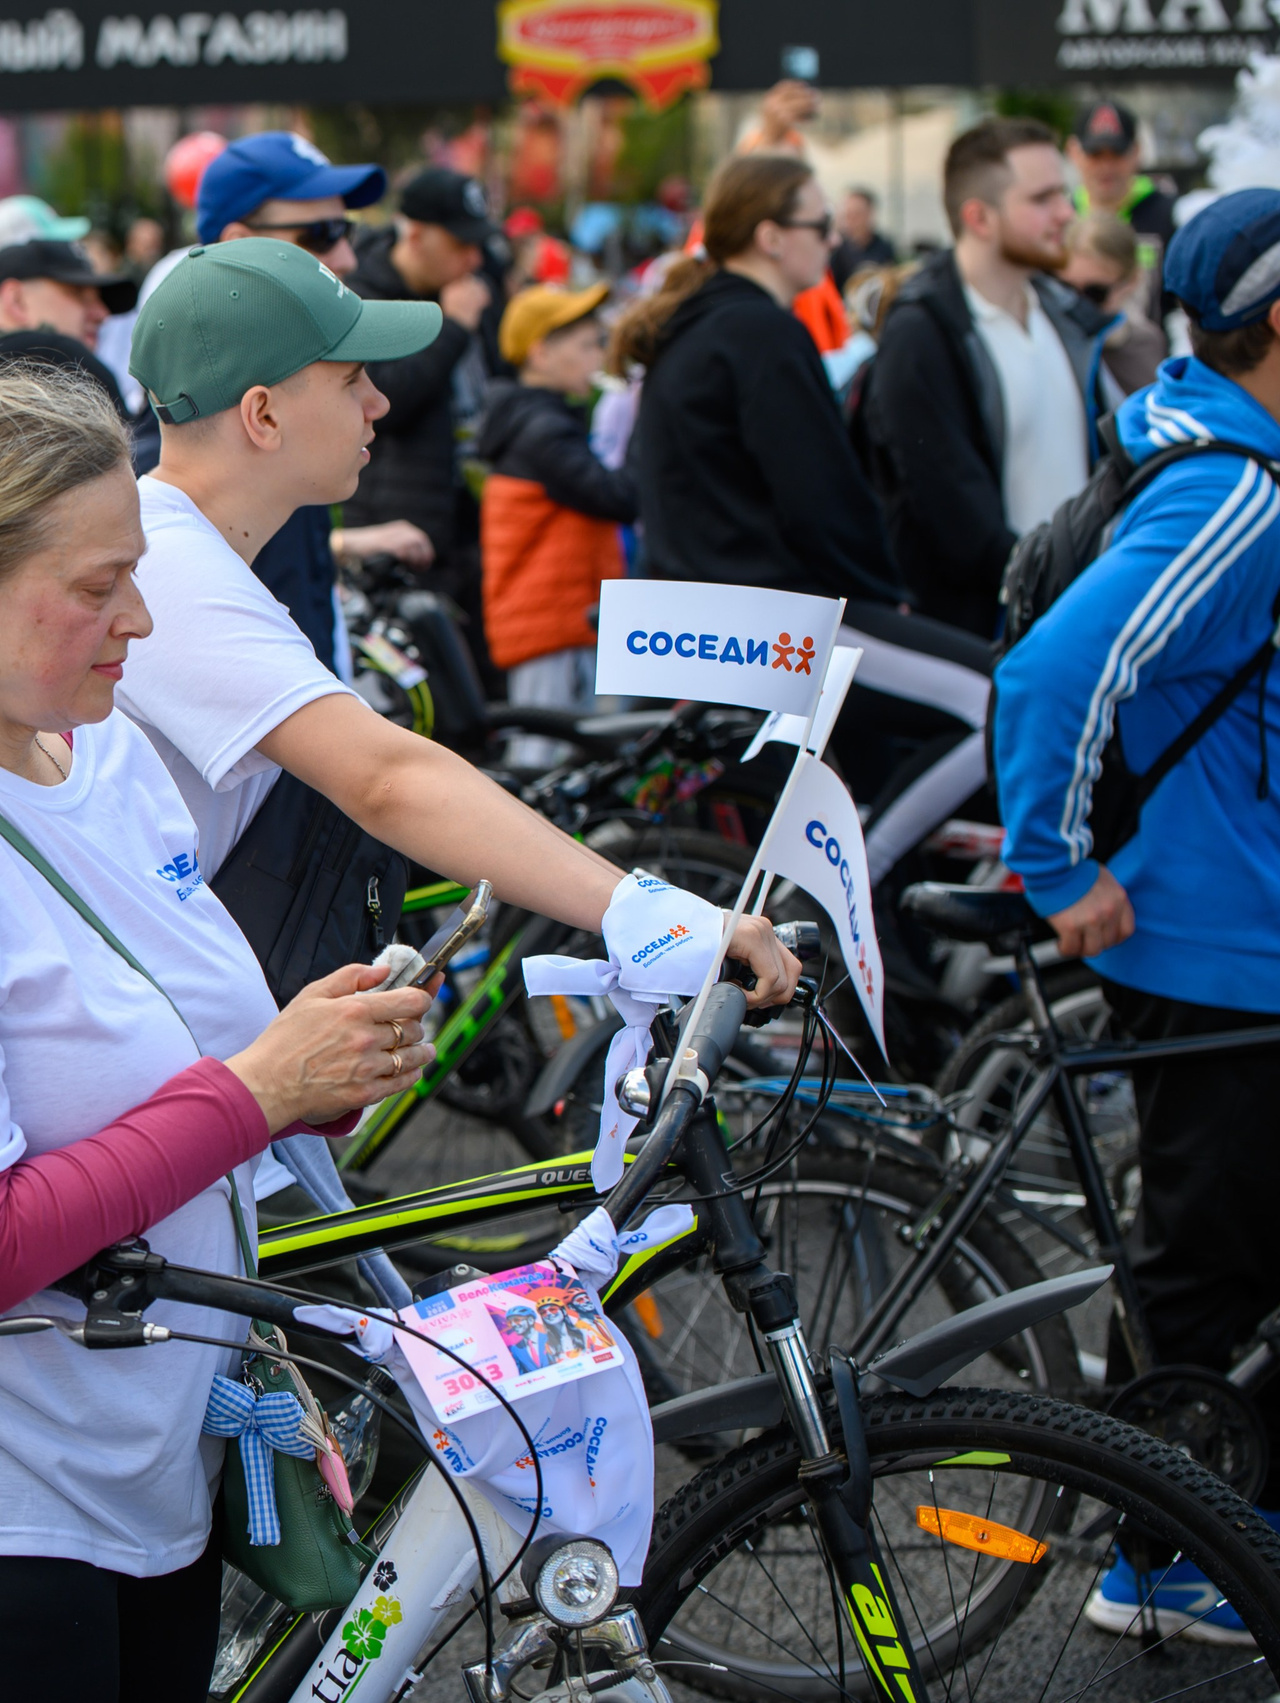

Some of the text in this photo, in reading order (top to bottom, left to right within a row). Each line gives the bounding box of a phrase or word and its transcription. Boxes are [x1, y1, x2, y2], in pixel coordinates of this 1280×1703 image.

[96, 9, 348, 68] МАГАЗИН
[626, 630, 768, 666] СОСЕДИ
[631, 934, 675, 964] СОСЕДИ
[457, 1272, 544, 1302] ВелоКоманда
